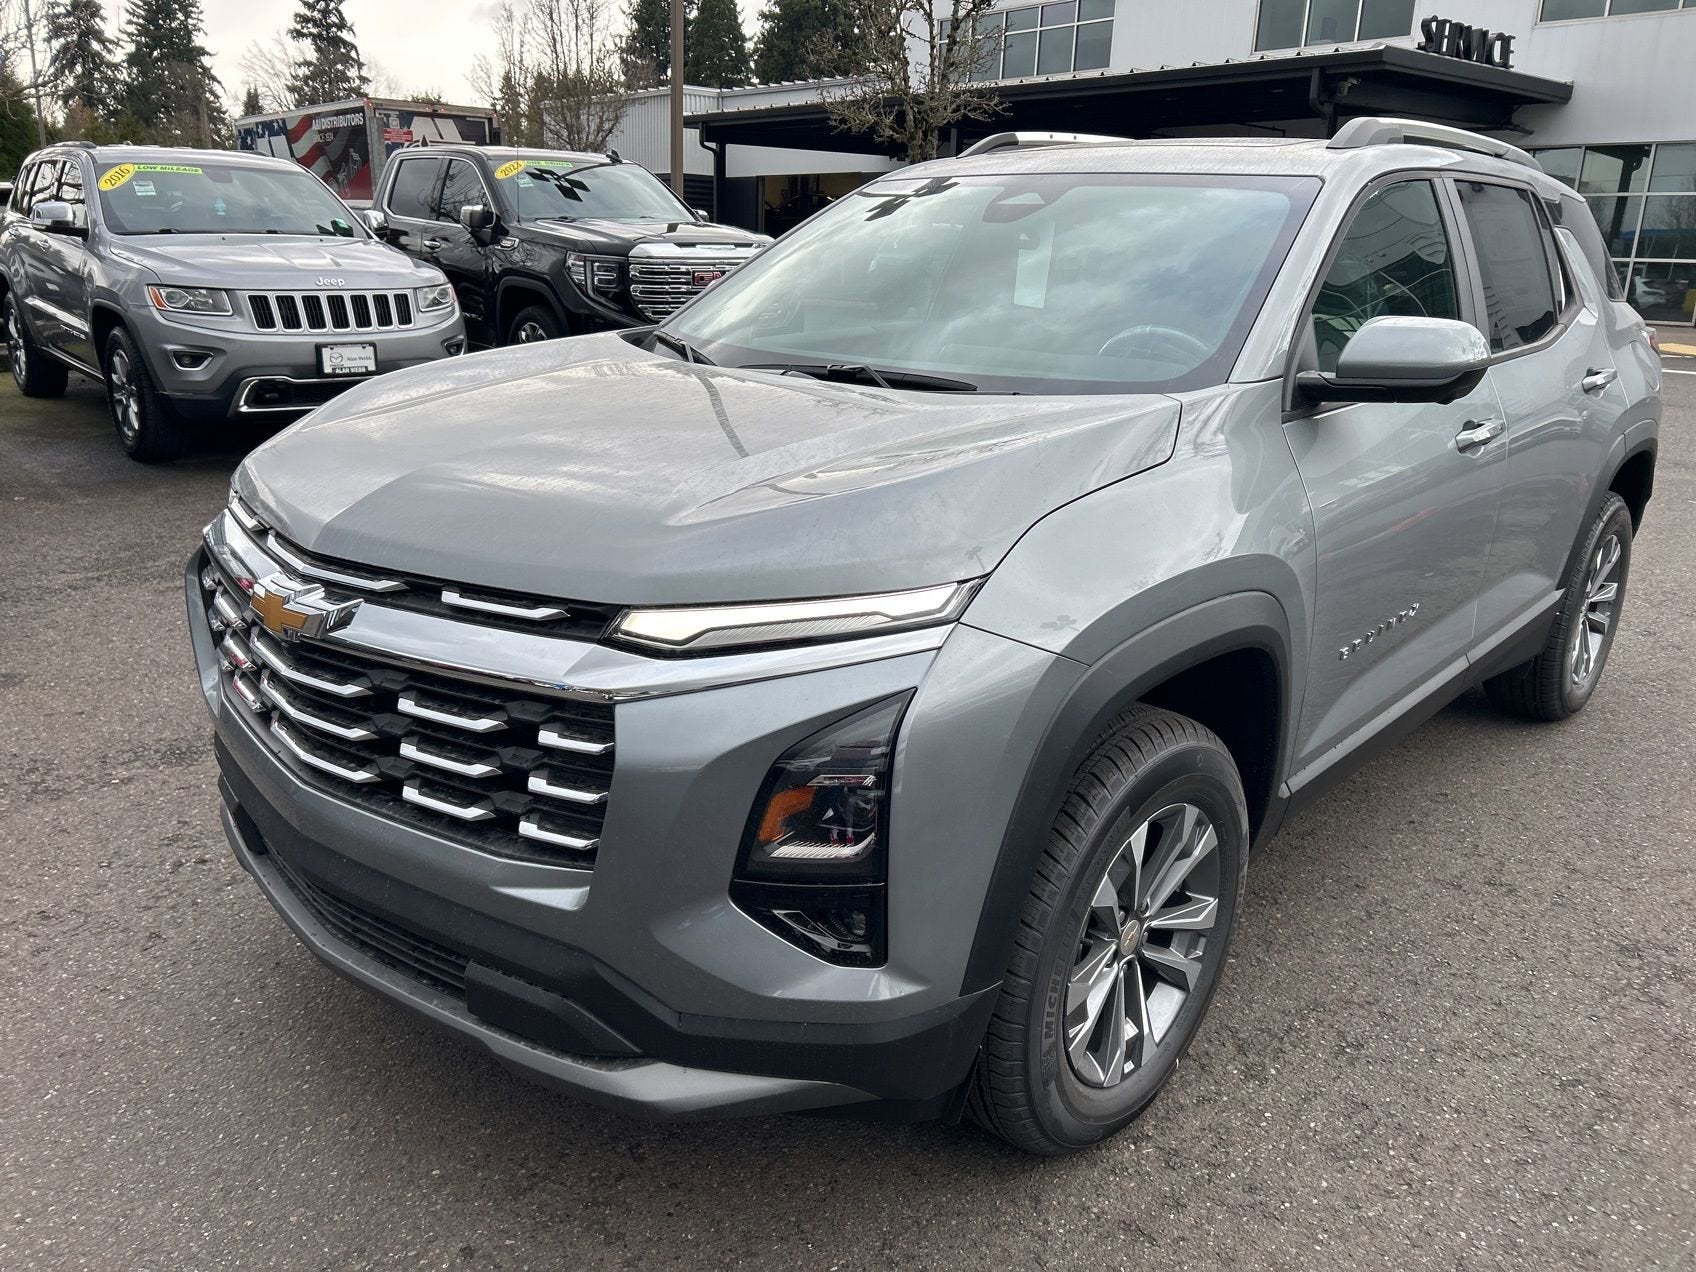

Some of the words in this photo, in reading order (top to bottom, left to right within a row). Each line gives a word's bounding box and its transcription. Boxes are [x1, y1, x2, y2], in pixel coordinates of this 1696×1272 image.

[321, 112, 364, 129] DISTRIBUTORS
[104, 166, 131, 187] 2016
[500, 161, 522, 177] 2023
[315, 276, 345, 288] Jeep
